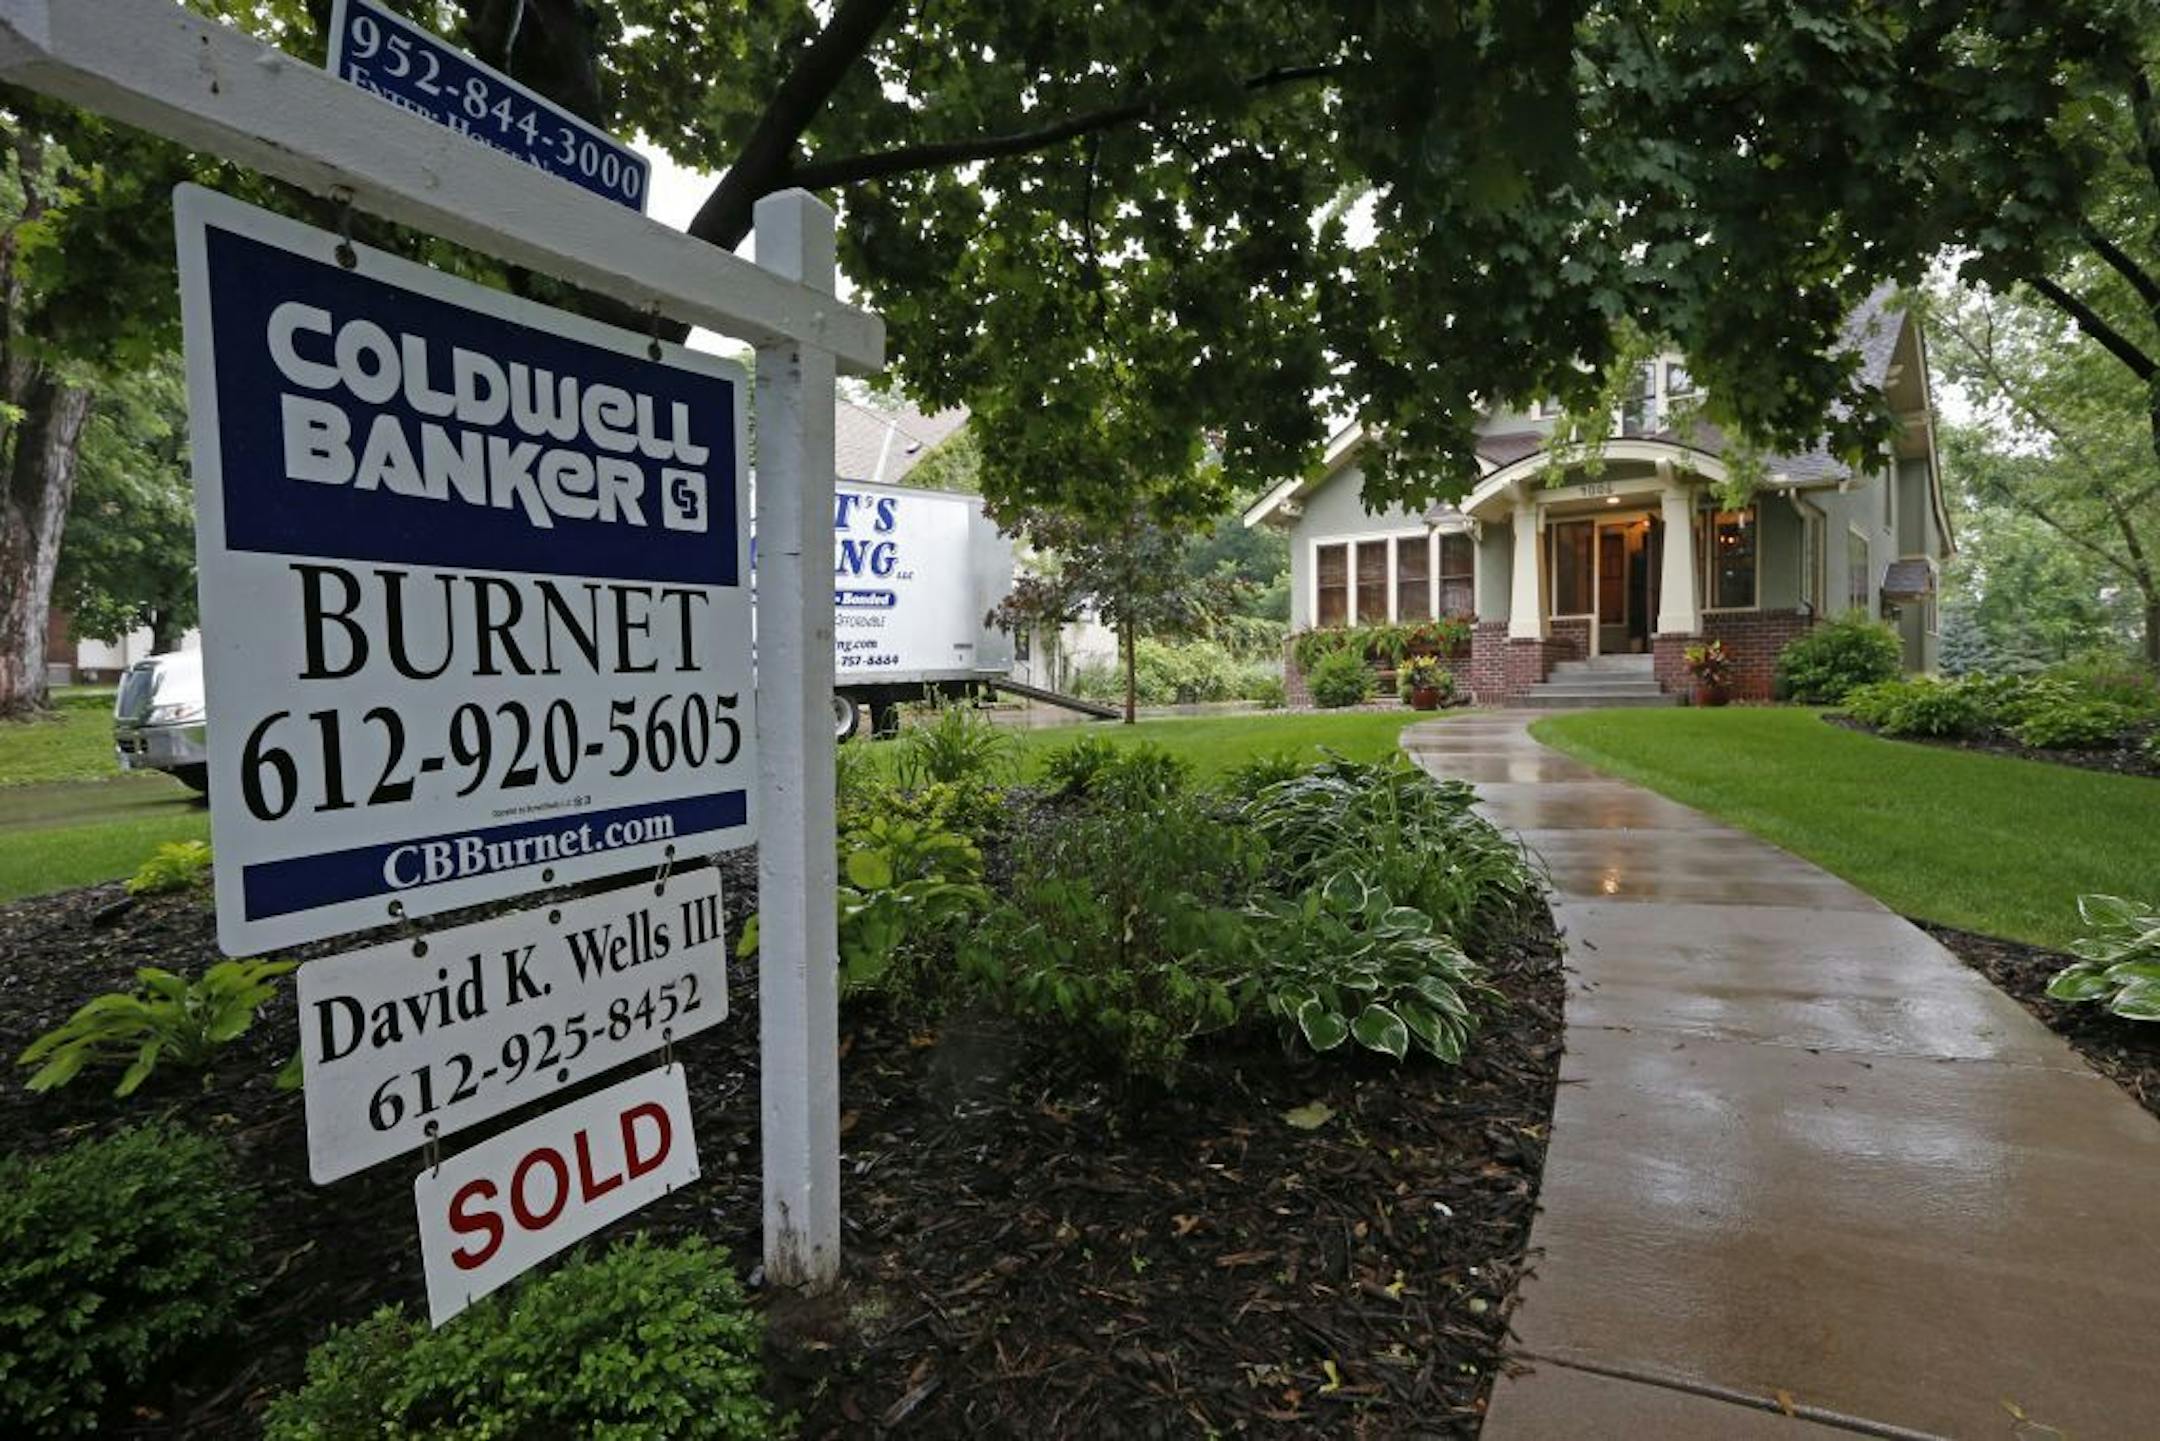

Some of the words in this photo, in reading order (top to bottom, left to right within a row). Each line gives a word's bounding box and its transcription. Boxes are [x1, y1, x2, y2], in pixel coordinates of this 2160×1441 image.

[351, 15, 641, 199] 952-844-3000
[267, 300, 710, 466] COLDWELL
[280, 392, 648, 530] BANKER
[289, 563, 710, 681] BURNET
[241, 691, 741, 822] 612-920-5605
[382, 811, 676, 890] CBBurnet.com
[313, 954, 488, 1065] David
[502, 944, 552, 1007] K.
[565, 908, 671, 984] Wells
[681, 894, 721, 950] III
[369, 972, 701, 1132] 612-925-8452
[447, 1101, 673, 1271] SOLD
